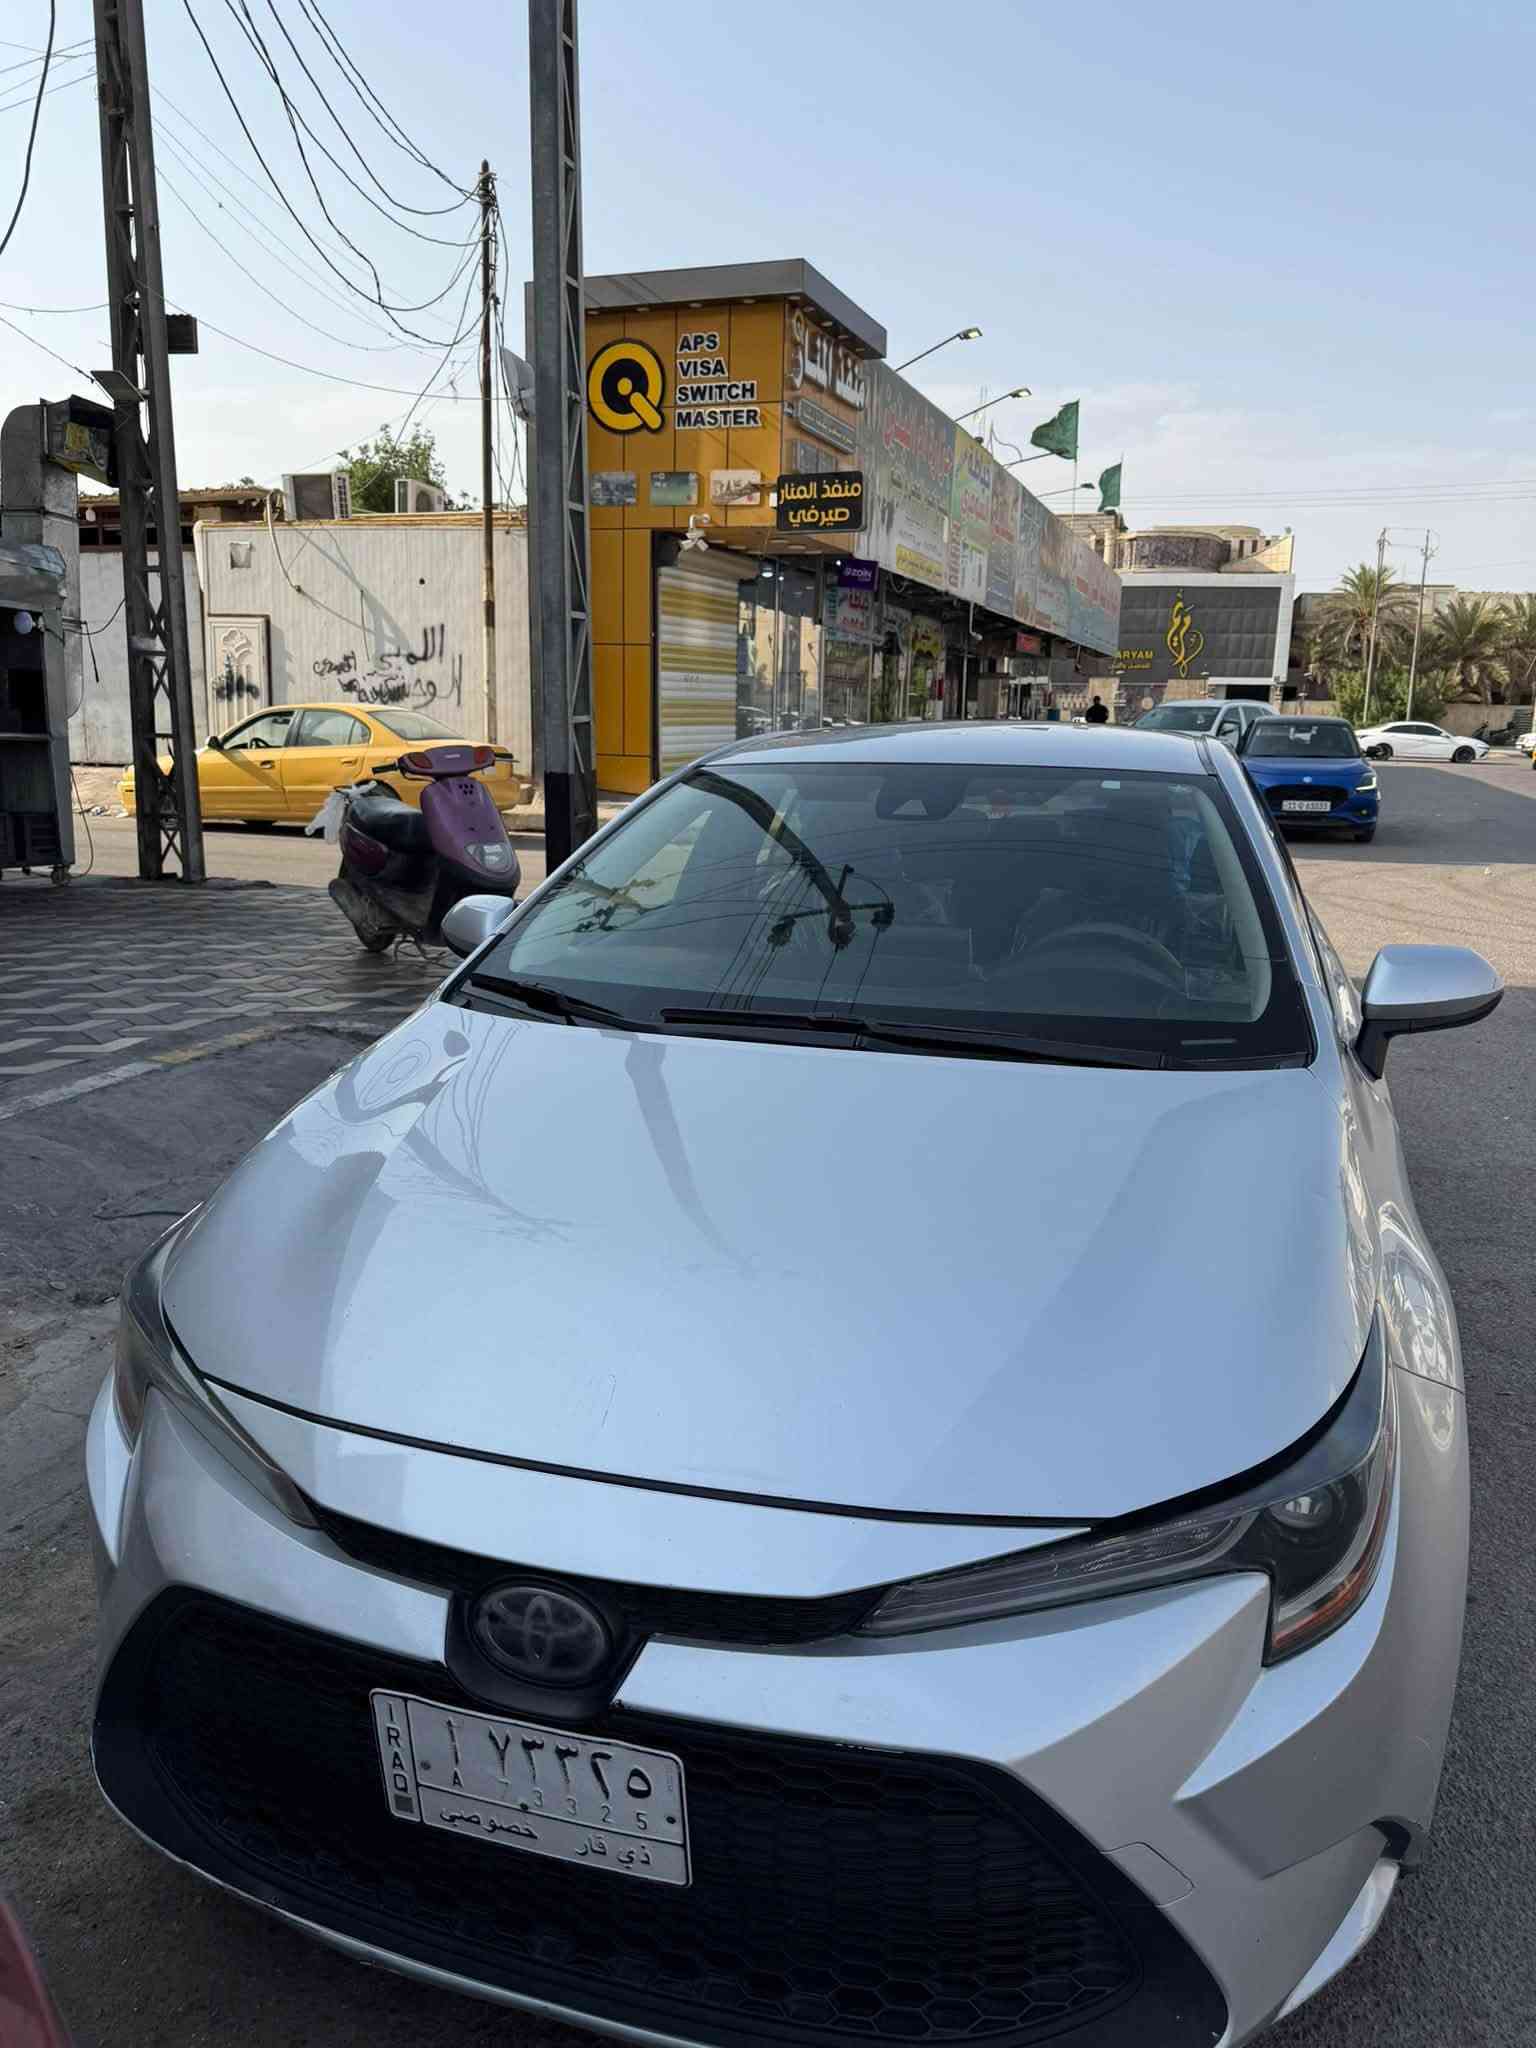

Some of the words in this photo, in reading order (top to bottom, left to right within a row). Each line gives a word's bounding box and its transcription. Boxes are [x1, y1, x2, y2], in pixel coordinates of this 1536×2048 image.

[678, 332, 720, 354] APS
[677, 357, 727, 378] VISA
[676, 381, 757, 404] SWITCH
[675, 407, 761, 430] MASTER
[778, 480, 817, 508] المنار
[820, 480, 862, 500] منفذ
[788, 504, 850, 526] صيرفي
[384, 1702, 409, 1793] IRAQ
[488, 1725, 652, 1802] ٧٣٣٢٥
[452, 1768, 465, 1788] A
[440, 1808, 540, 1840] خصوصي
[575, 1834, 609, 1857] قار
[617, 1843, 653, 1868] ذي
